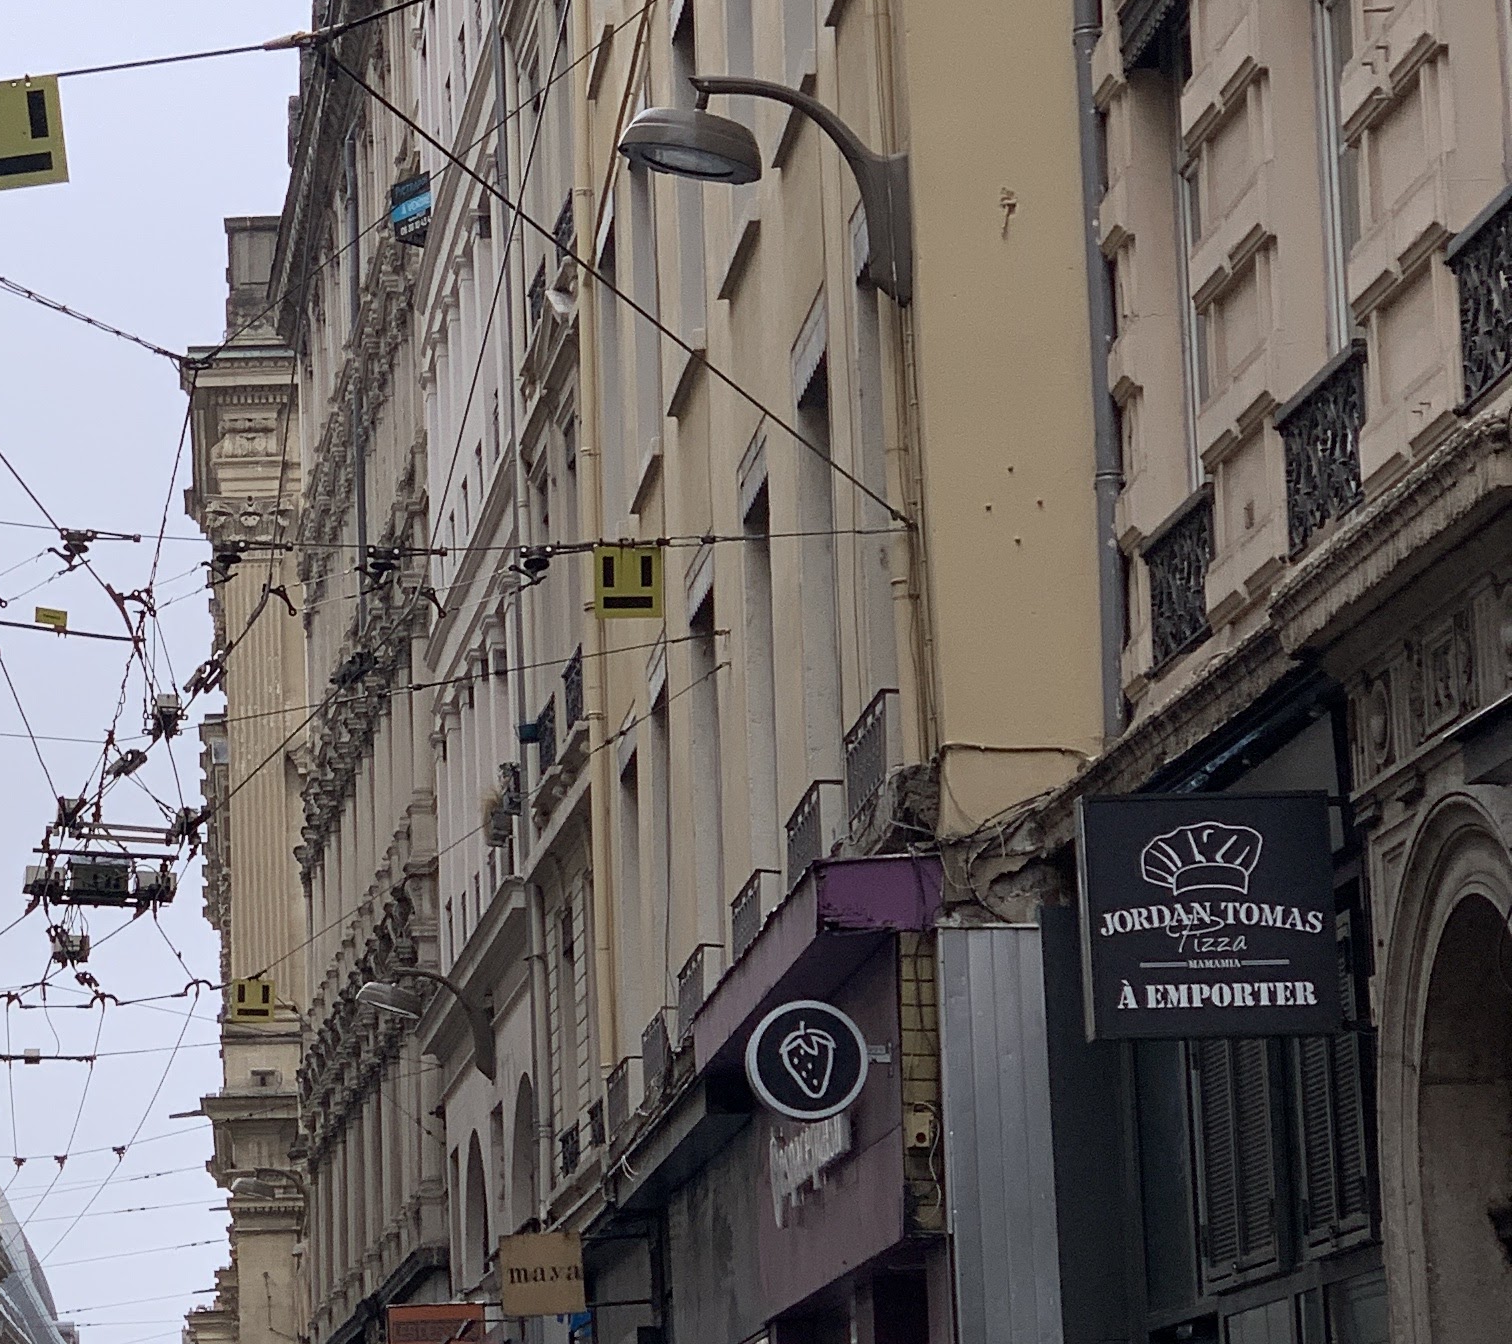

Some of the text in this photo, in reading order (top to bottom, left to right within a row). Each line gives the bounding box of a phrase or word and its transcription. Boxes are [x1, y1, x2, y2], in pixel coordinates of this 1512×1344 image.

[1100, 902, 1324, 936] JORDAN TOMAS
[1166, 914, 1247, 953] Pizza
[1188, 958, 1241, 969] MAMAMIA
[1118, 979, 1317, 1009] À EMPORTER
[509, 1265, 582, 1285] maya
